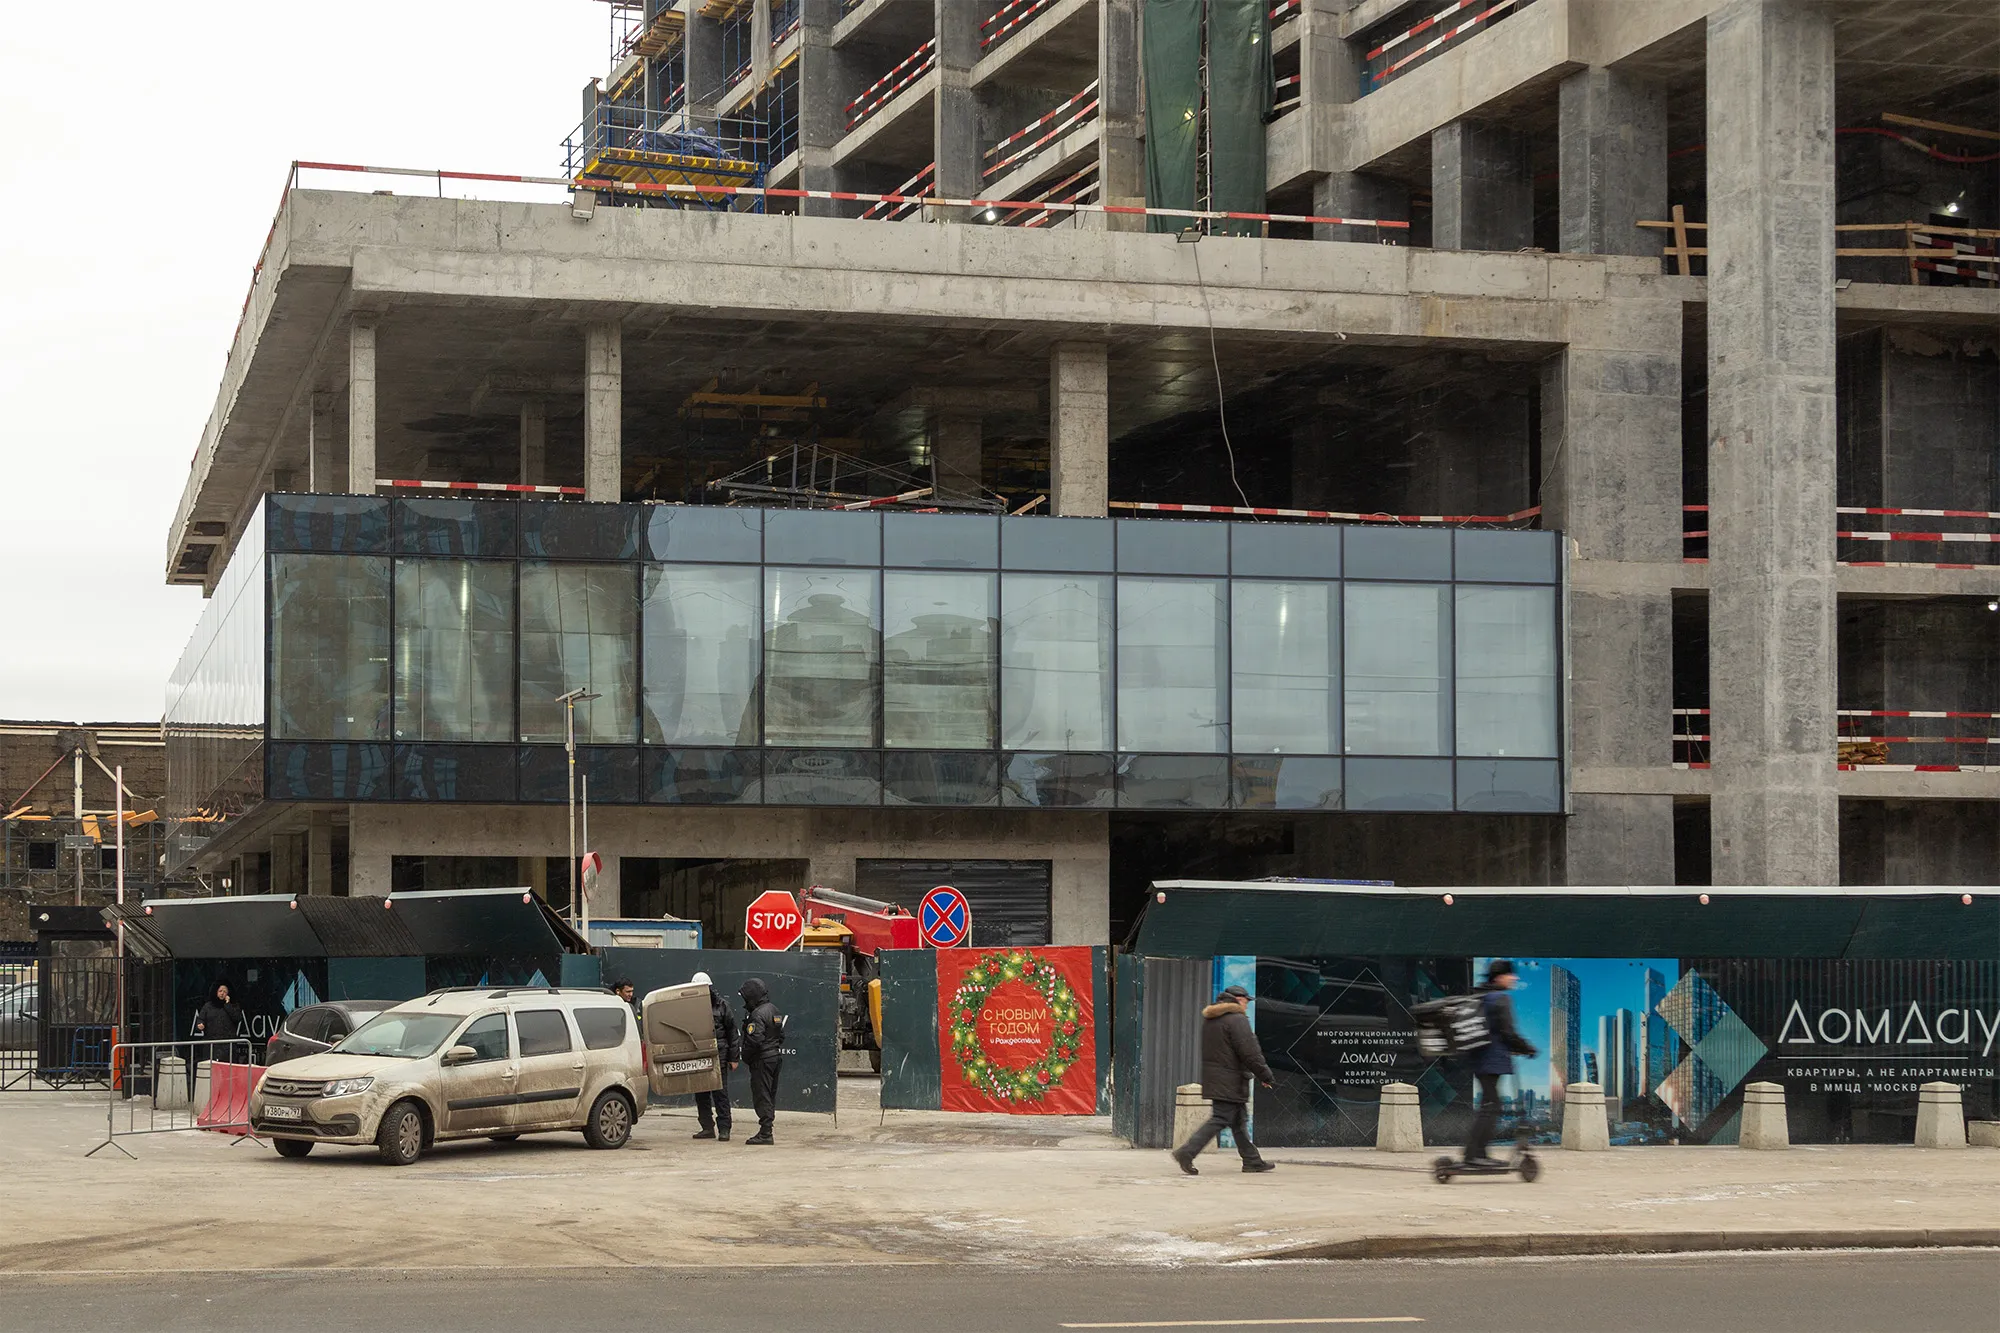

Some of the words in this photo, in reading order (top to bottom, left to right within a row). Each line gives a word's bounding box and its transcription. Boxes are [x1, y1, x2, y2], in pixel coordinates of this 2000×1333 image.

[752, 912, 797, 930] STOP
[983, 1009, 993, 1021] С
[995, 1008, 1046, 1021] НОВЫМ
[990, 1022, 1040, 1035] ГОДОМ
[995, 1037, 1041, 1046] Рождеством
[1787, 1068, 1860, 1077] КВАРТИРЫ,
[1866, 1068, 1874, 1077] А
[1880, 1068, 1896, 1077] НЕ
[1901, 1068, 1994, 1077] АПАРТАМЕНТЫ
[1810, 1083, 1818, 1092] В
[1824, 1083, 1861, 1093] ММЦД
